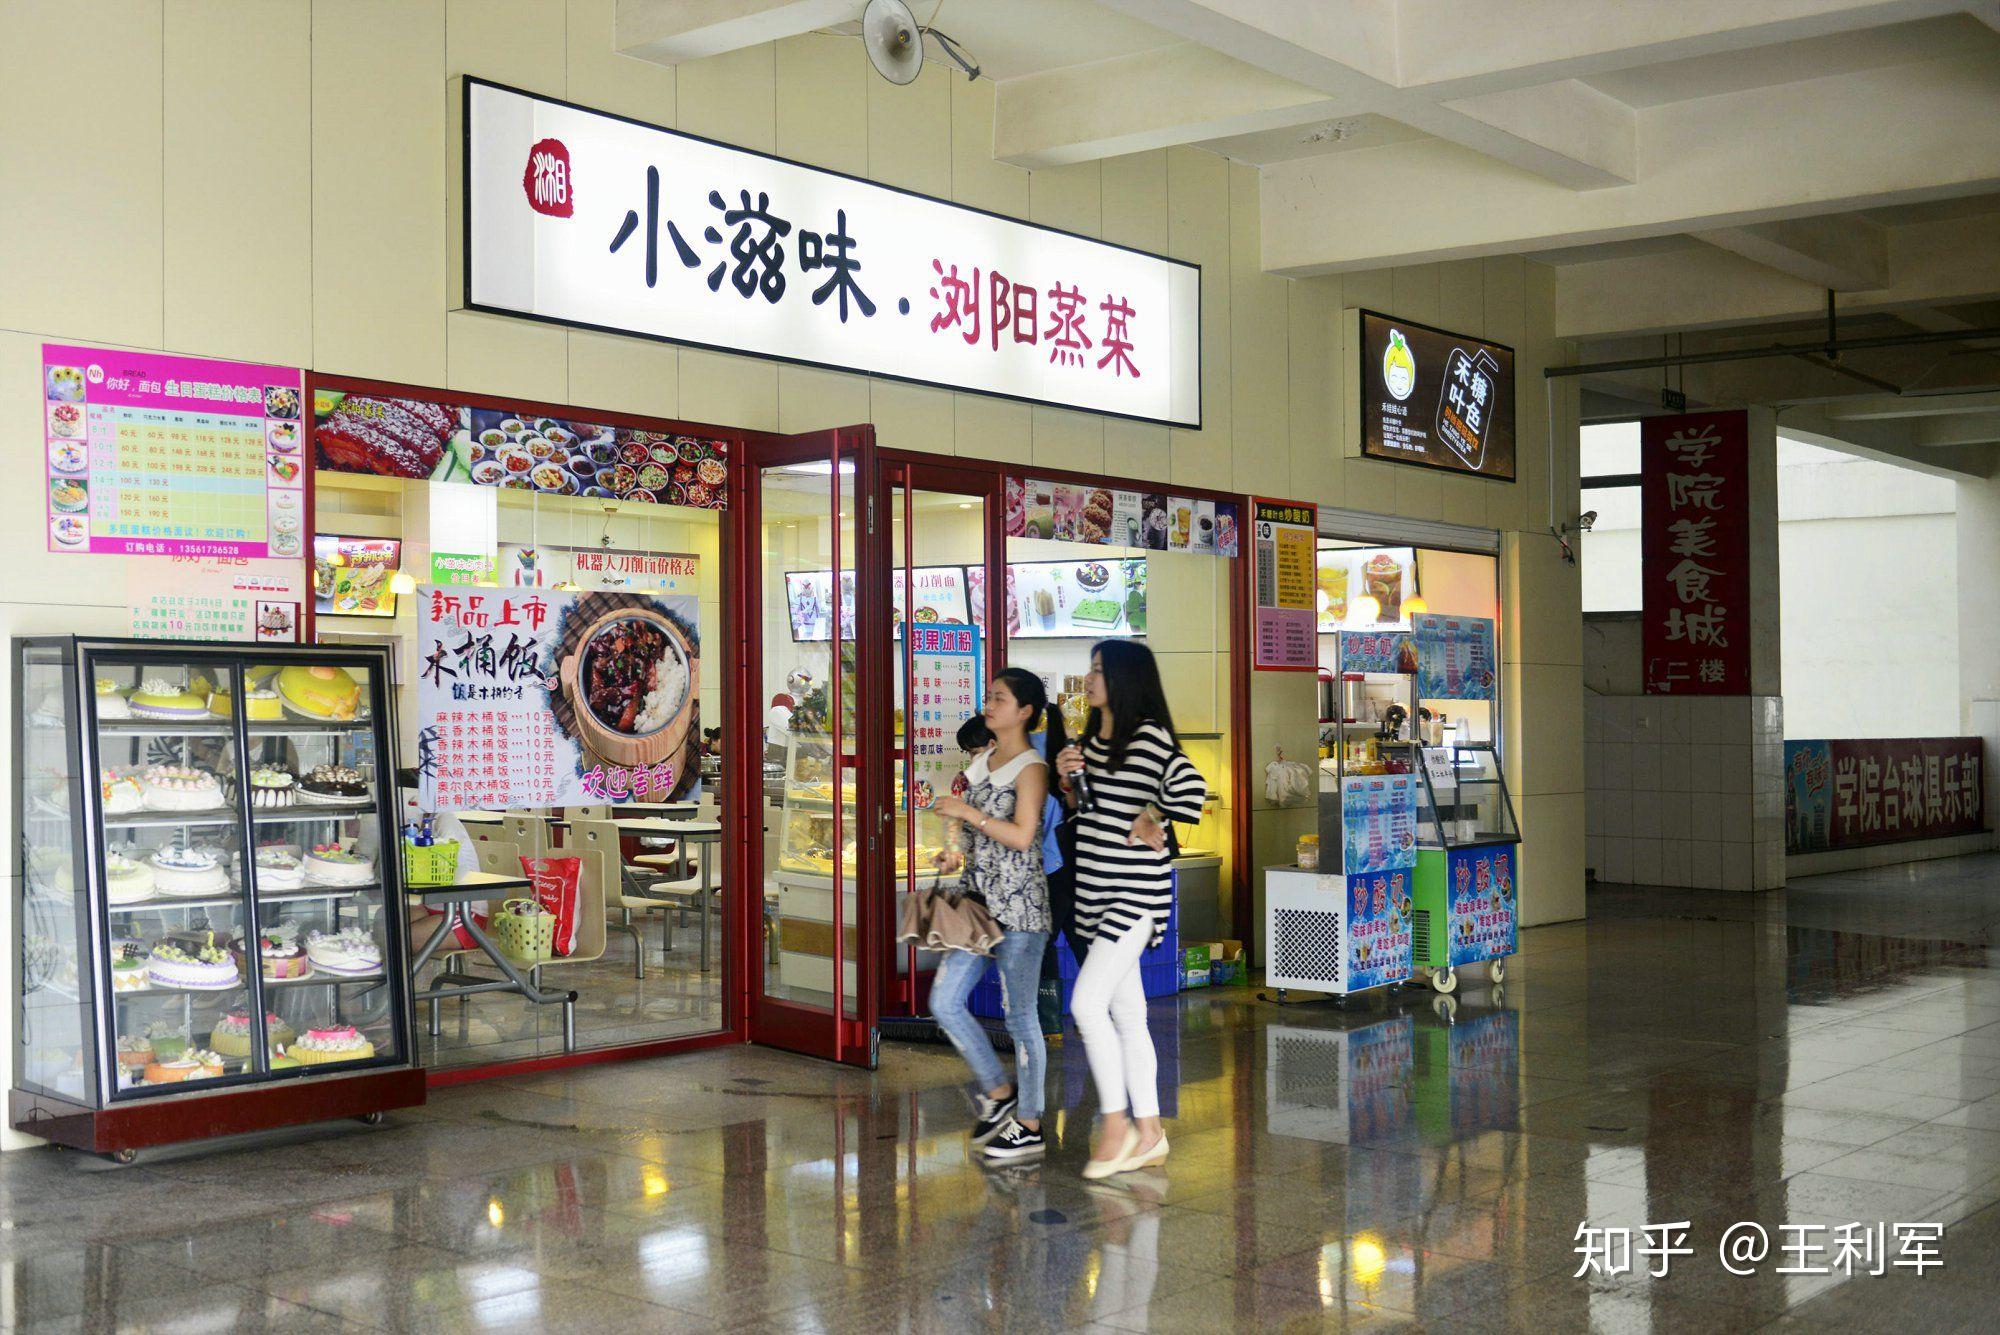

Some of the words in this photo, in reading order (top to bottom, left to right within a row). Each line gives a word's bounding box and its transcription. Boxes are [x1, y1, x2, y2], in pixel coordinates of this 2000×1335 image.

[164, 379, 263, 404] 生日蛋糕价格表
[1663, 424, 1729, 648] 学院美食城
[576, 552, 696, 576] 机器人刀削面价格表
[430, 590, 548, 632] 新品上市
[421, 630, 549, 688] 木桶饭
[1836, 752, 1981, 836] 学院台球俱乐部
